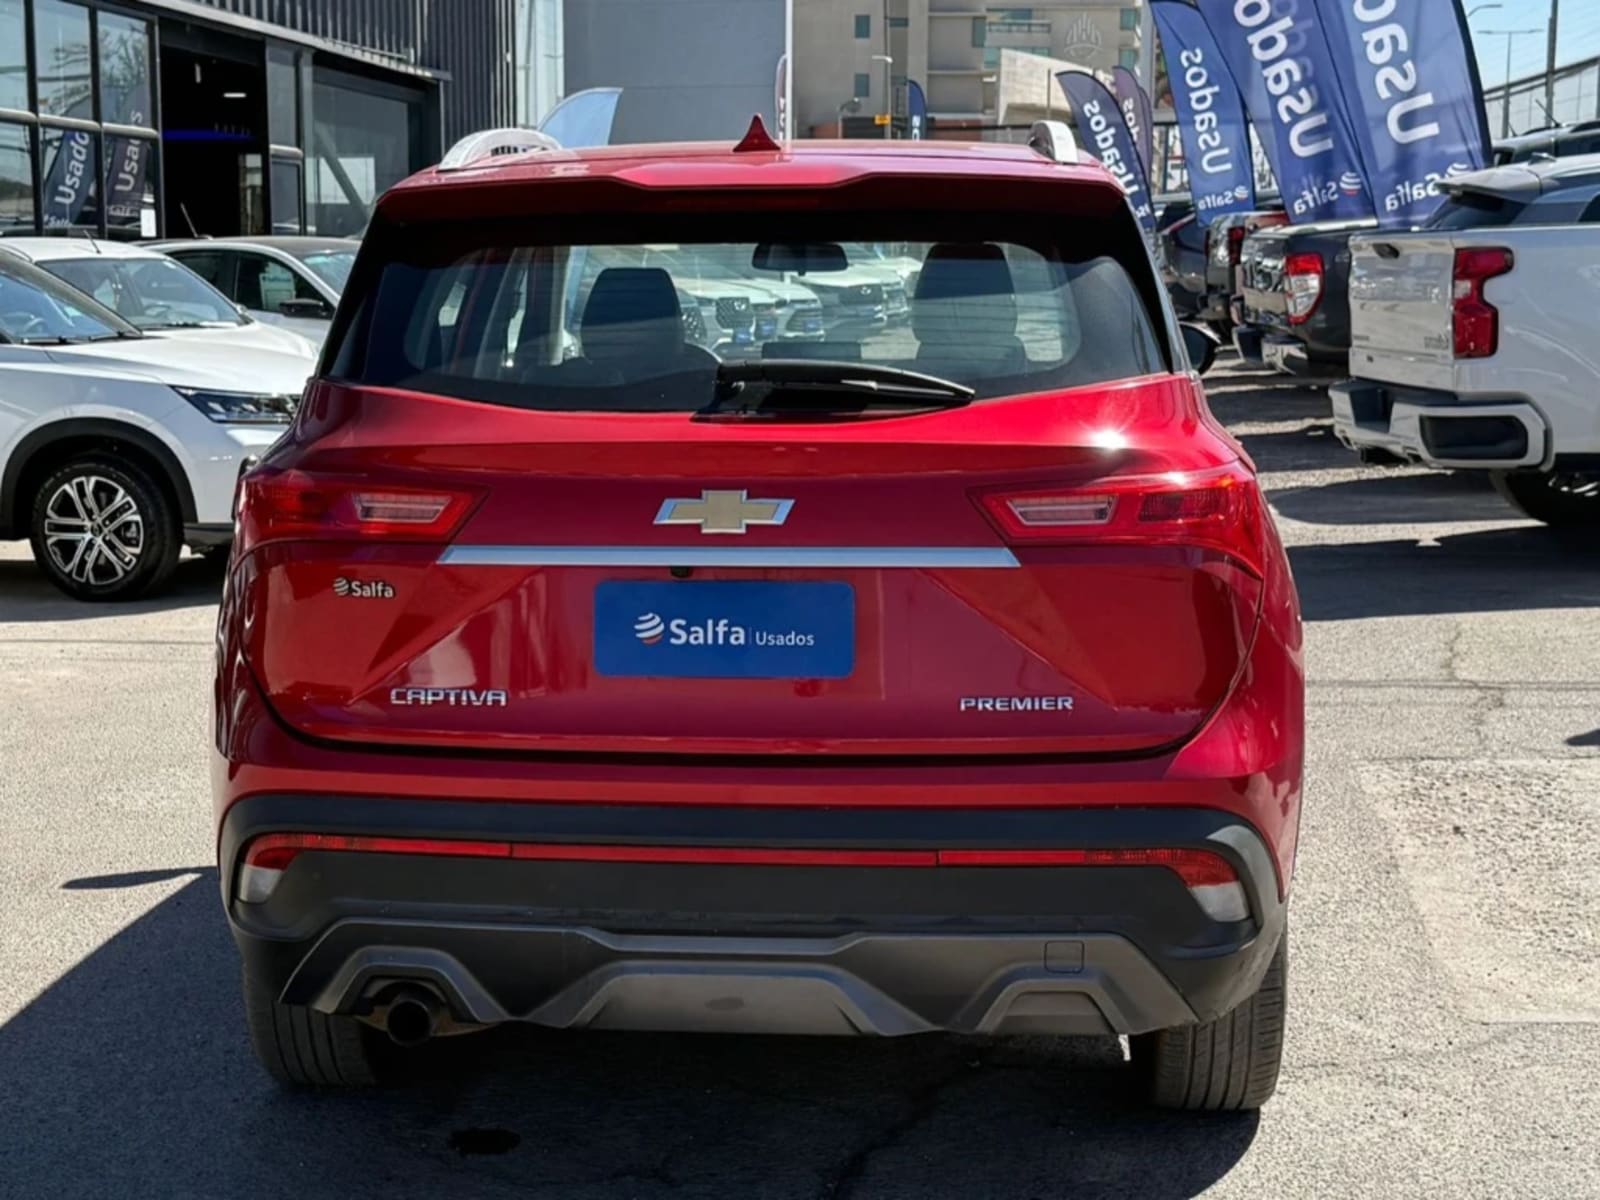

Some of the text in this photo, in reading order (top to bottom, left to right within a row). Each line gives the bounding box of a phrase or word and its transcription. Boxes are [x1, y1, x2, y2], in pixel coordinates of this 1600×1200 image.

[54, 131, 90, 205] Usado
[351, 580, 394, 598] Salfa
[669, 618, 815, 646] Salfa Usados
[390, 688, 506, 706] CAPTIVA
[960, 696, 1074, 712] PREMIER
